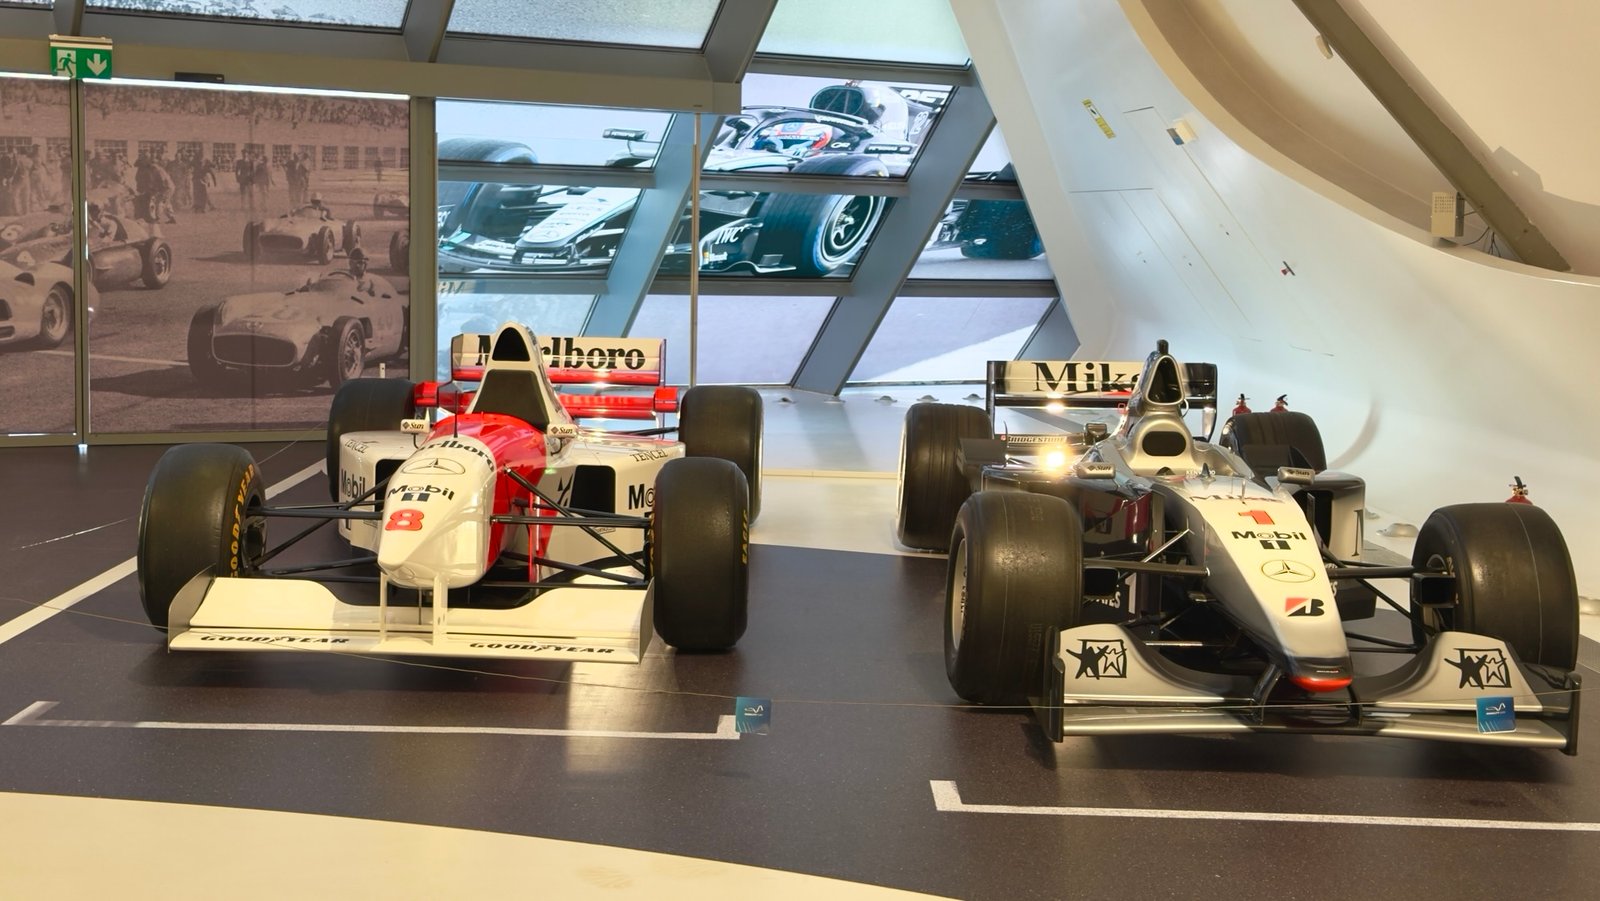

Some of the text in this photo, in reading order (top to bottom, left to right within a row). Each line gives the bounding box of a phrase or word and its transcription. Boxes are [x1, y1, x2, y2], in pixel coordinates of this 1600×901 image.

[475, 334, 646, 370] Mrlboro
[410, 422, 425, 431] Sun
[558, 426, 574, 434] Sun
[419, 440, 495, 473] rlboro
[629, 448, 669, 463] TENCEL
[341, 468, 366, 498] Mobil
[387, 484, 455, 501] Mobil
[385, 508, 425, 531] 8
[1238, 509, 1275, 525] 1
[1231, 530, 1308, 541] Mobil
[200, 635, 350, 644] GOODYEAR
[469, 642, 615, 654] GOODYEAR
